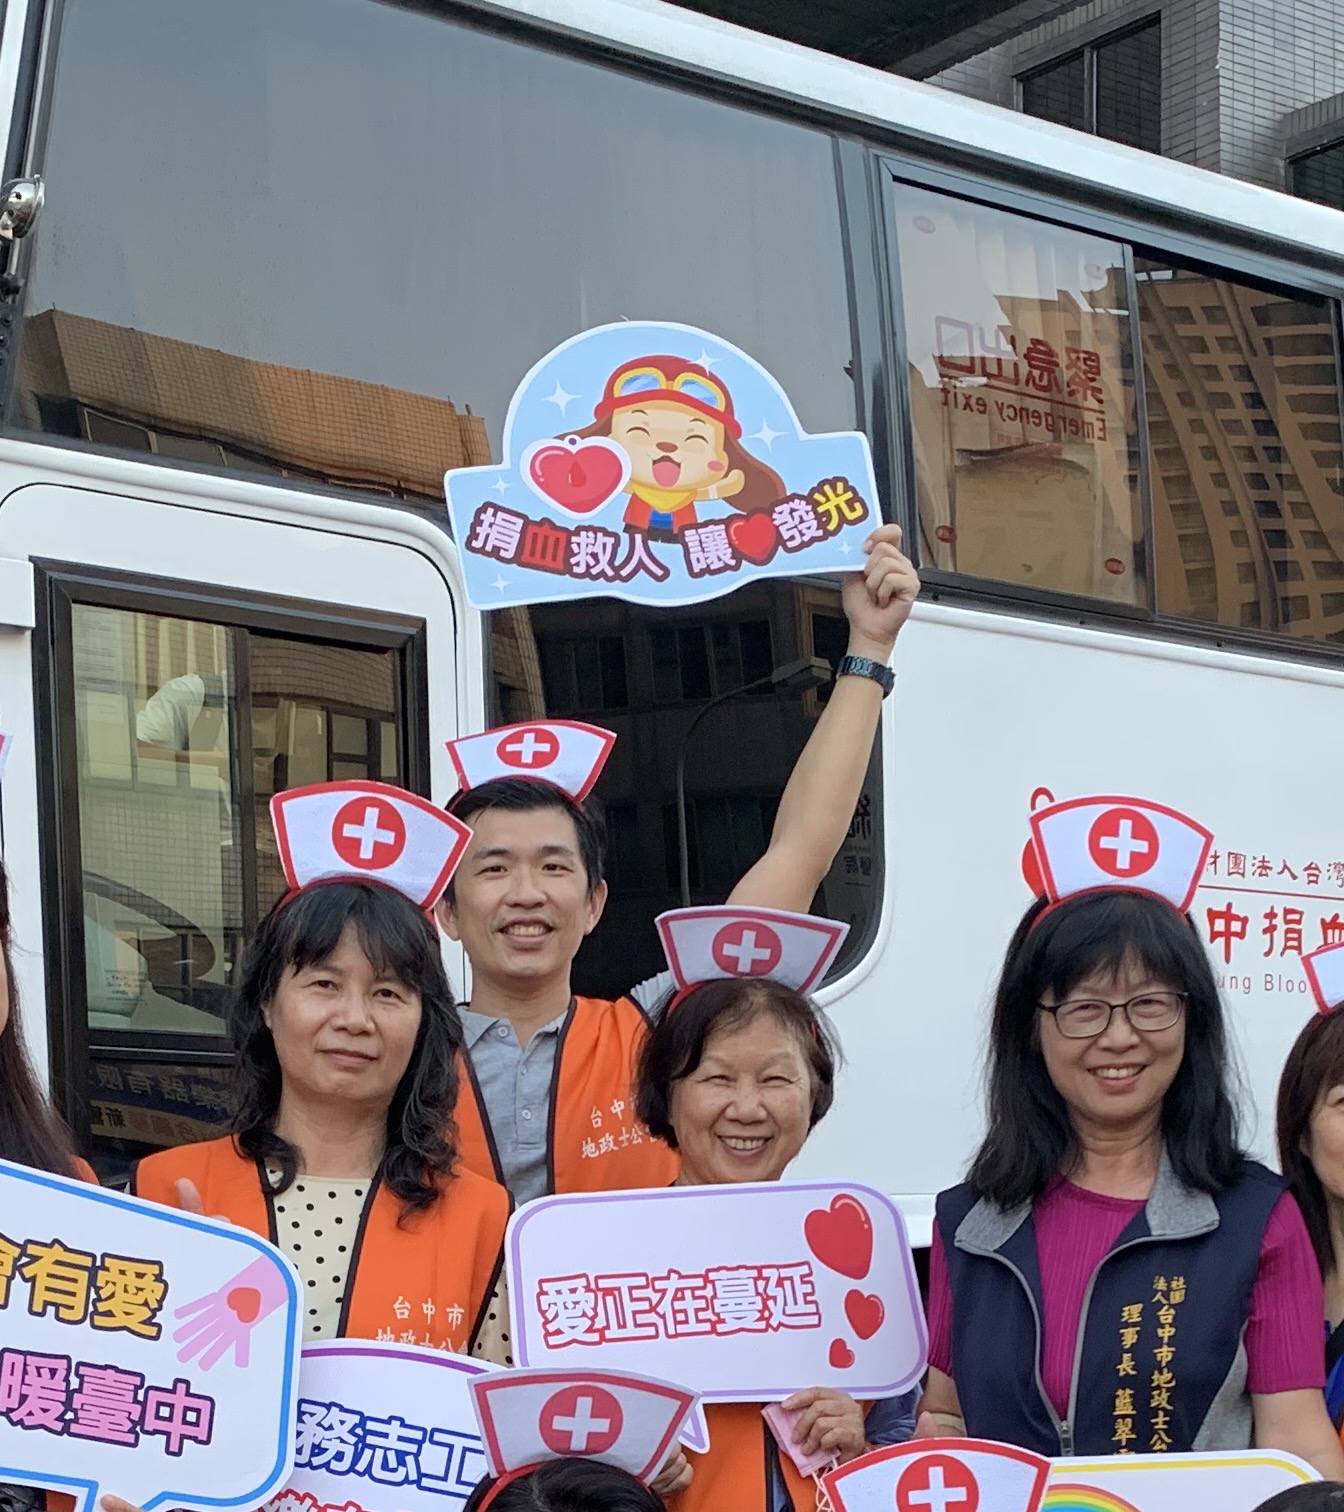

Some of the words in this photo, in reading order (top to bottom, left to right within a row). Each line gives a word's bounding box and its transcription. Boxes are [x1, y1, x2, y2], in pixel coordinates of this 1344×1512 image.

[468, 505, 667, 581] 捐血救人
[376, 1326, 468, 1354] 地政士公
[393, 1295, 465, 1331] 台中市
[538, 1261, 822, 1349] 愛正在蔓延
[1116, 1302, 1144, 1377] 理事長
[1112, 1388, 1137, 1456] 藍翠
